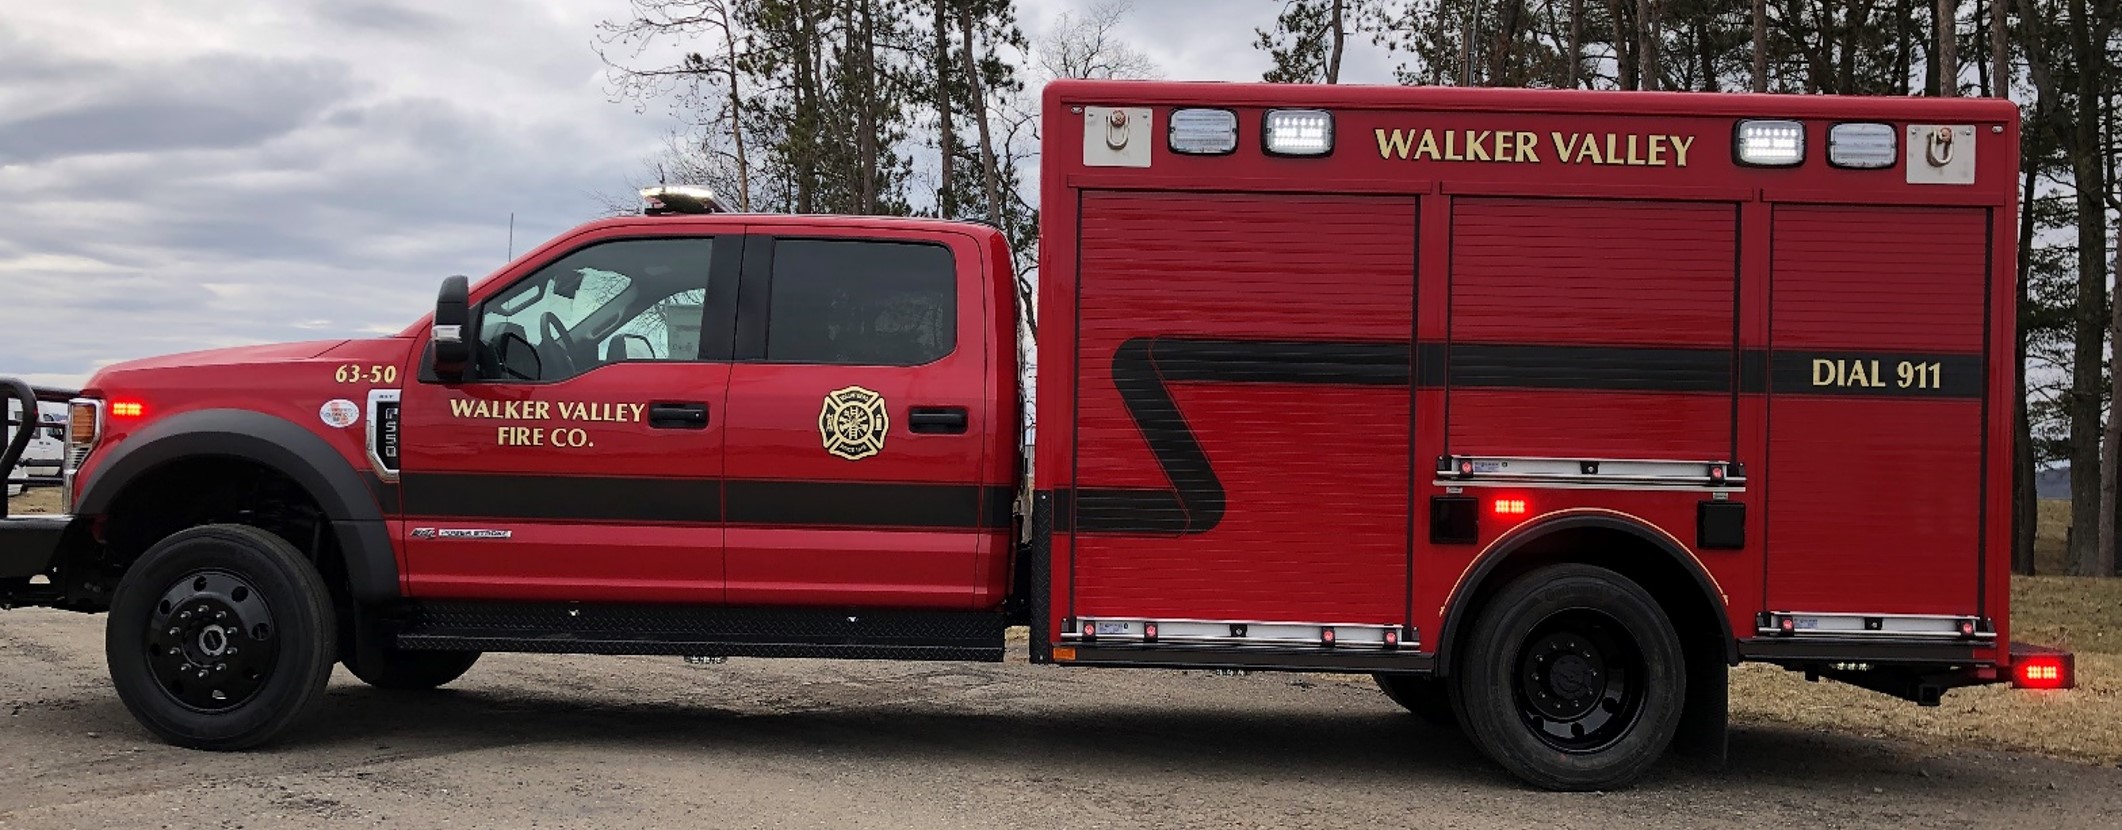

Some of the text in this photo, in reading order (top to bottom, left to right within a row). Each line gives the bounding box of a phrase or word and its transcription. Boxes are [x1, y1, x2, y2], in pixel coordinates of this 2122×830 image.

[1374, 128, 1695, 167] WALKER VALLEY
[335, 364, 397, 383] 63-50
[1812, 359, 1941, 389] DIAL 911
[450, 399, 646, 423] WALKER VALLEY
[497, 426, 594, 448] FIRE CO.
